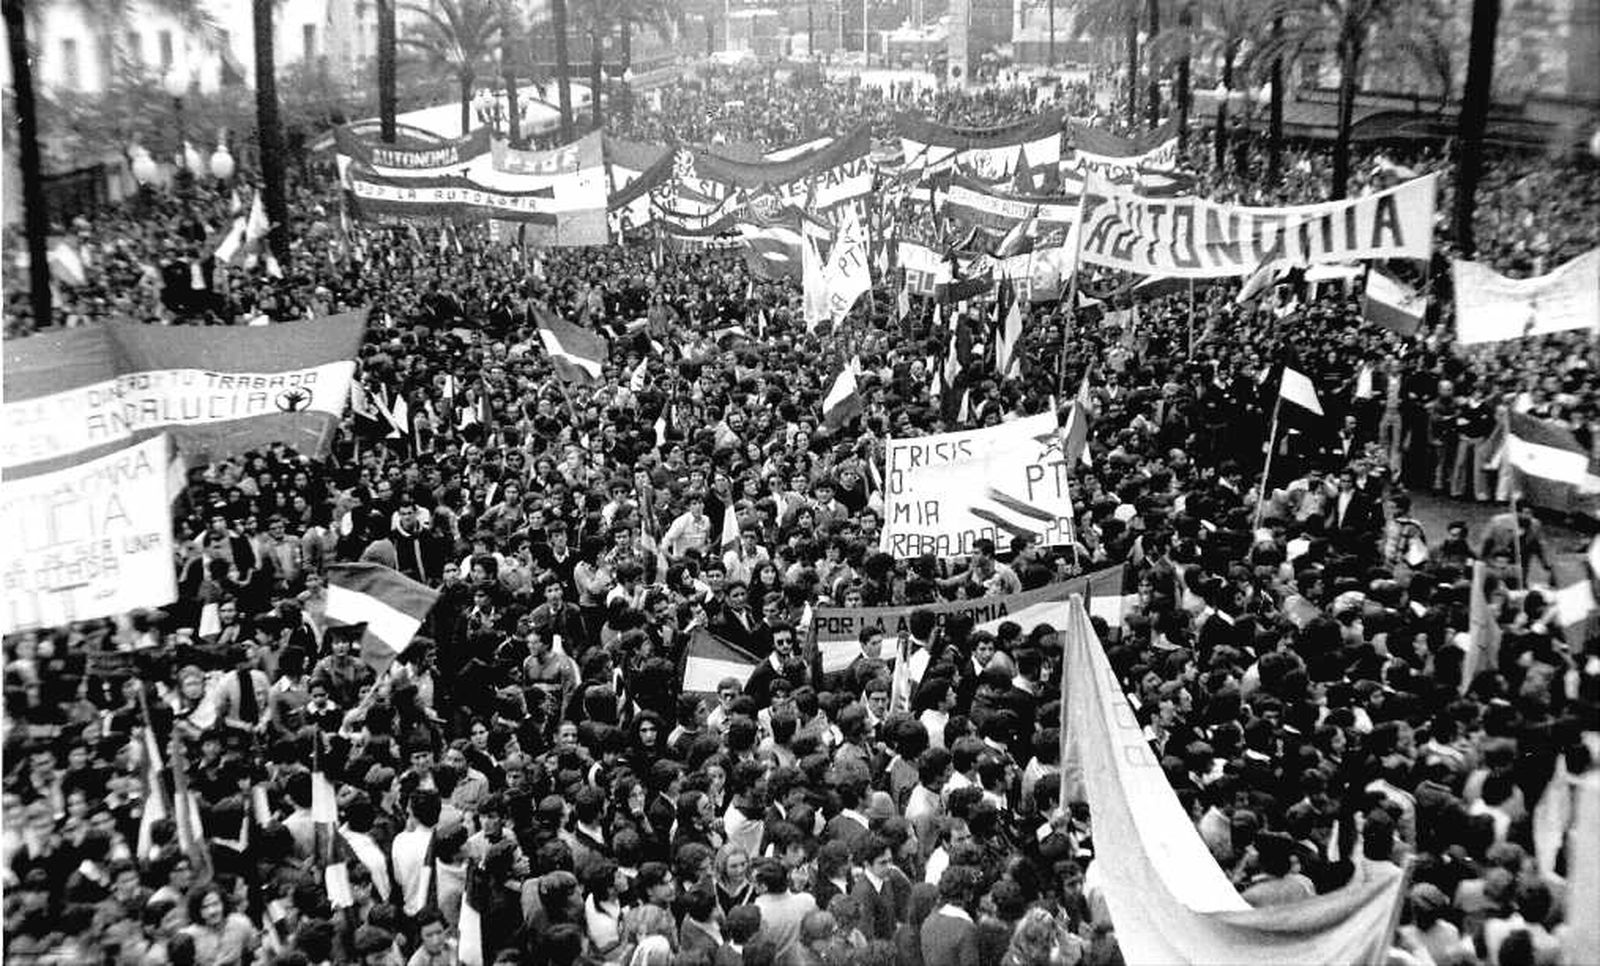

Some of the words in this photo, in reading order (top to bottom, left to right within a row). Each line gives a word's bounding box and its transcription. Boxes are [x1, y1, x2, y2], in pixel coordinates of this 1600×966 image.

[372, 146, 458, 167] AUTONOMIA
[204, 371, 318, 390] TRABAJO
[1025, 460, 1066, 502] PT
[893, 500, 940, 527] MIA
[815, 606, 853, 634] POR
